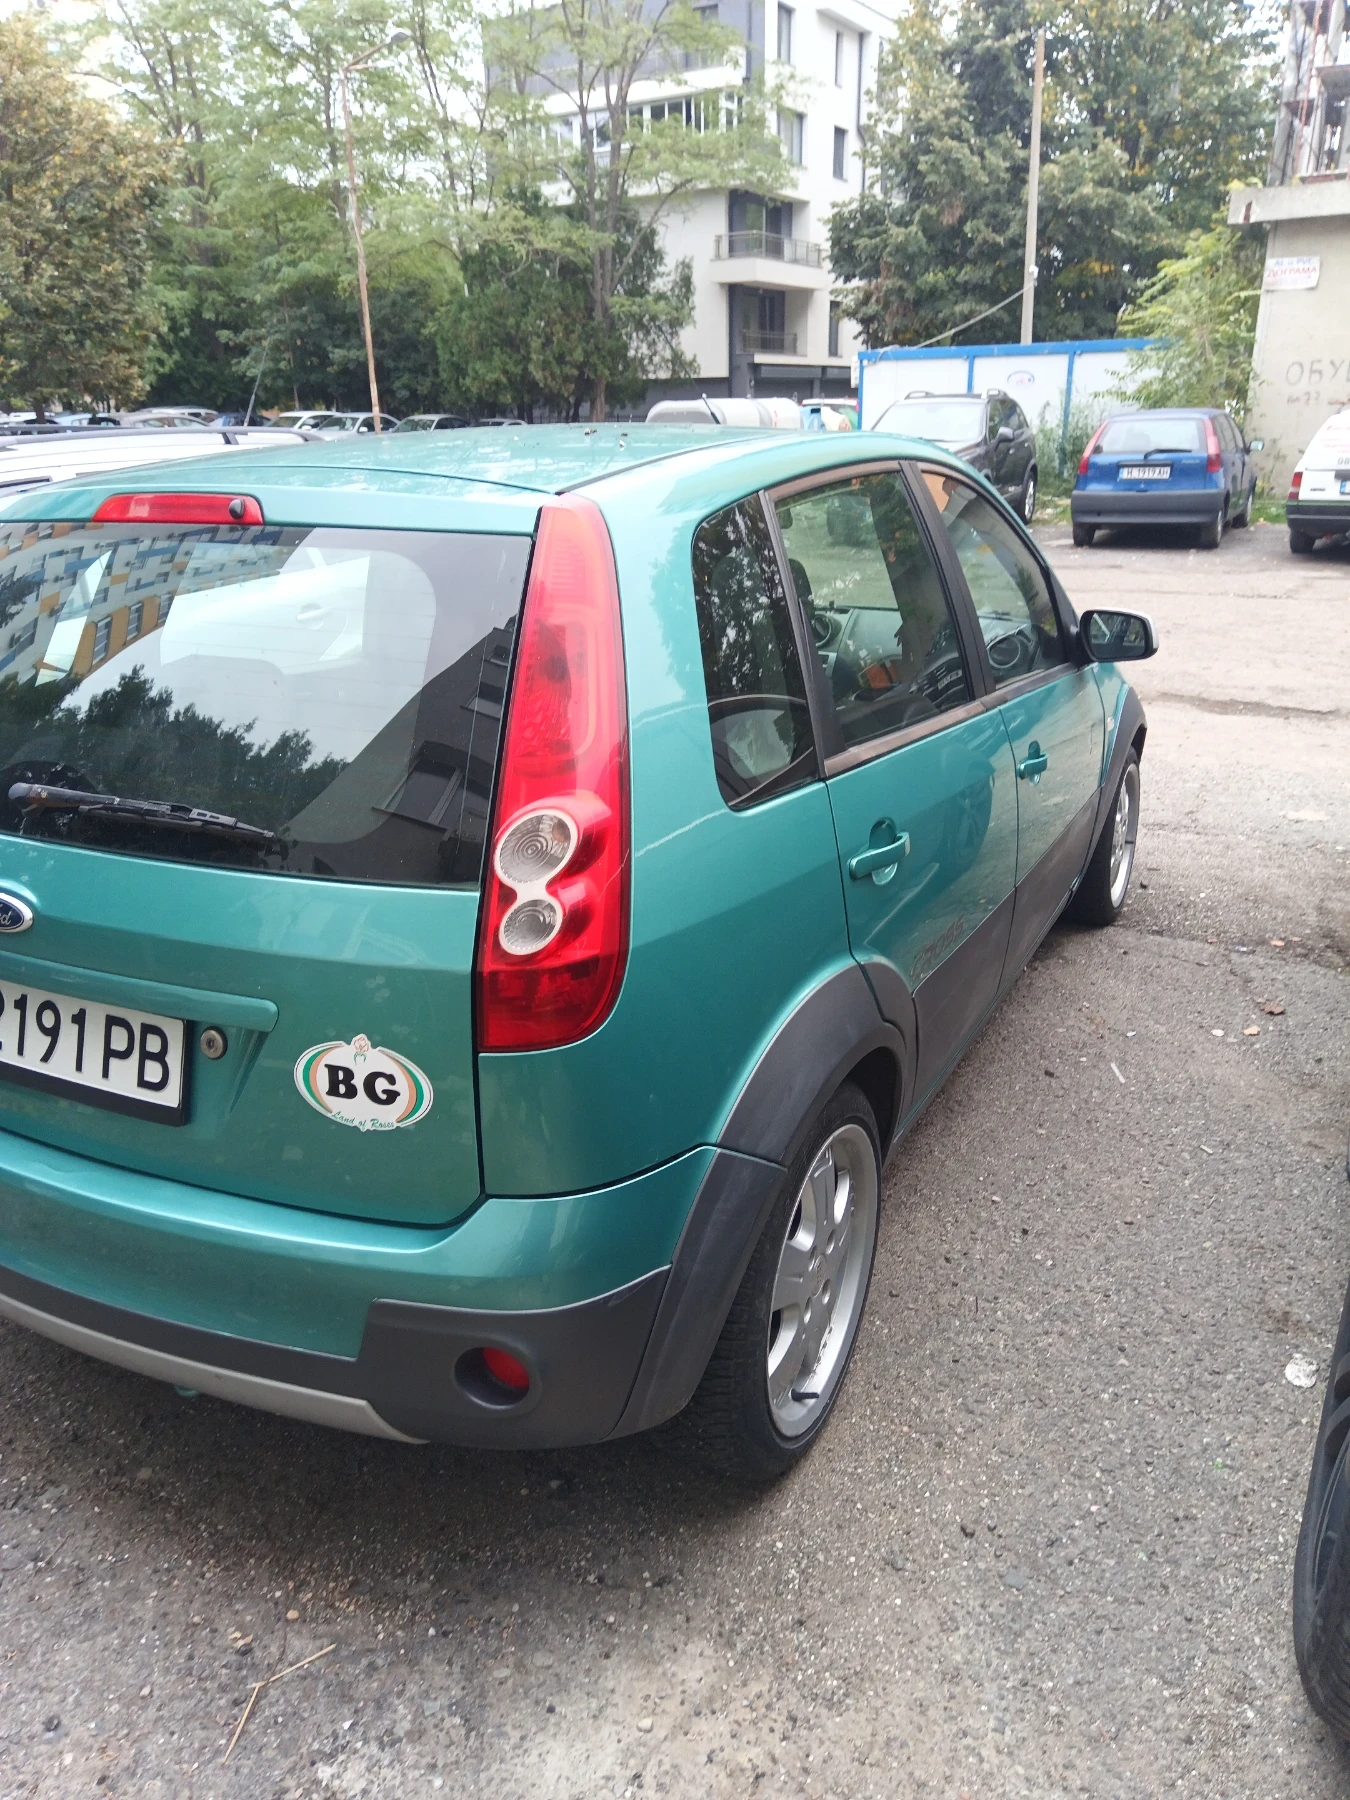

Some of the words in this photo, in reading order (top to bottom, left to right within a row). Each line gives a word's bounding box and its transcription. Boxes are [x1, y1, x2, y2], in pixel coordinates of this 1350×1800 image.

[324, 1063, 401, 1106] BG
[331, 1111, 356, 1125] Land
[358, 1119, 367, 1130] of
[370, 1118, 395, 1129] Roses
